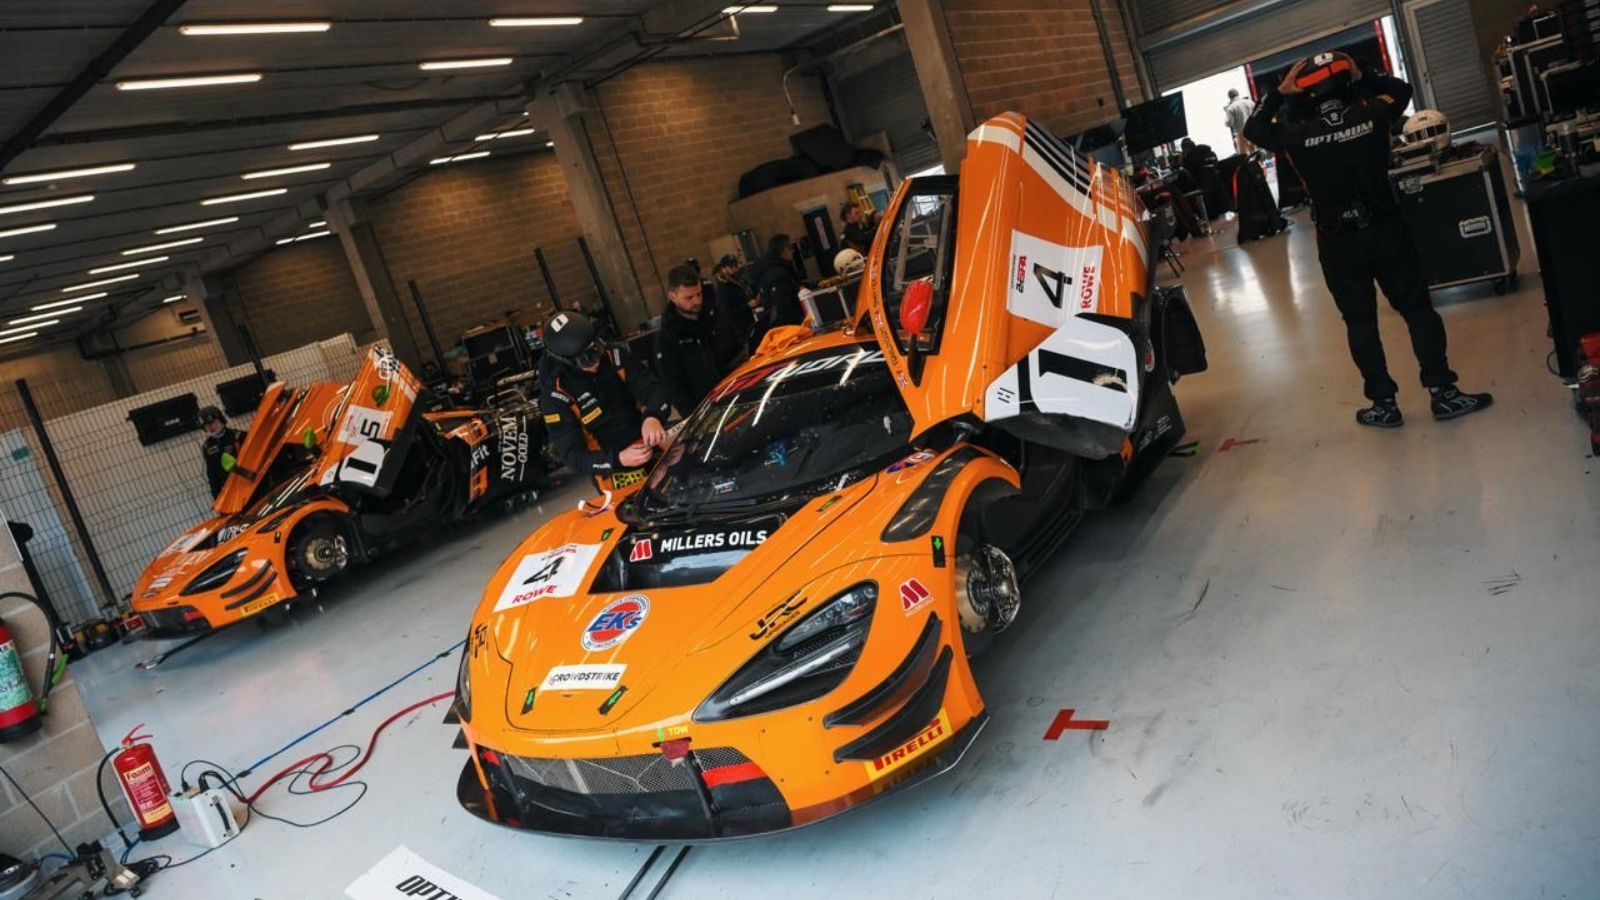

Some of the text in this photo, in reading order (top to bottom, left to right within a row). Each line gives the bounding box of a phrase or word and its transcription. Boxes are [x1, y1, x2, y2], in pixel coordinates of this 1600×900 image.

[1305, 120, 1374, 147] OPTIMUM
[1033, 263, 1073, 309] 4
[1081, 266, 1095, 309] ROWE
[501, 416, 517, 481] NOVEM
[518, 432, 529, 463] GOLD
[660, 533, 725, 553] MILLERS
[728, 530, 768, 546] OILS
[522, 556, 566, 586] 4
[511, 585, 557, 604] ROWE
[552, 671, 620, 683] CROWDSTRIKE
[668, 725, 689, 736] TOW
[873, 718, 943, 771] PIRELLI
[126, 765, 151, 781] Foam
